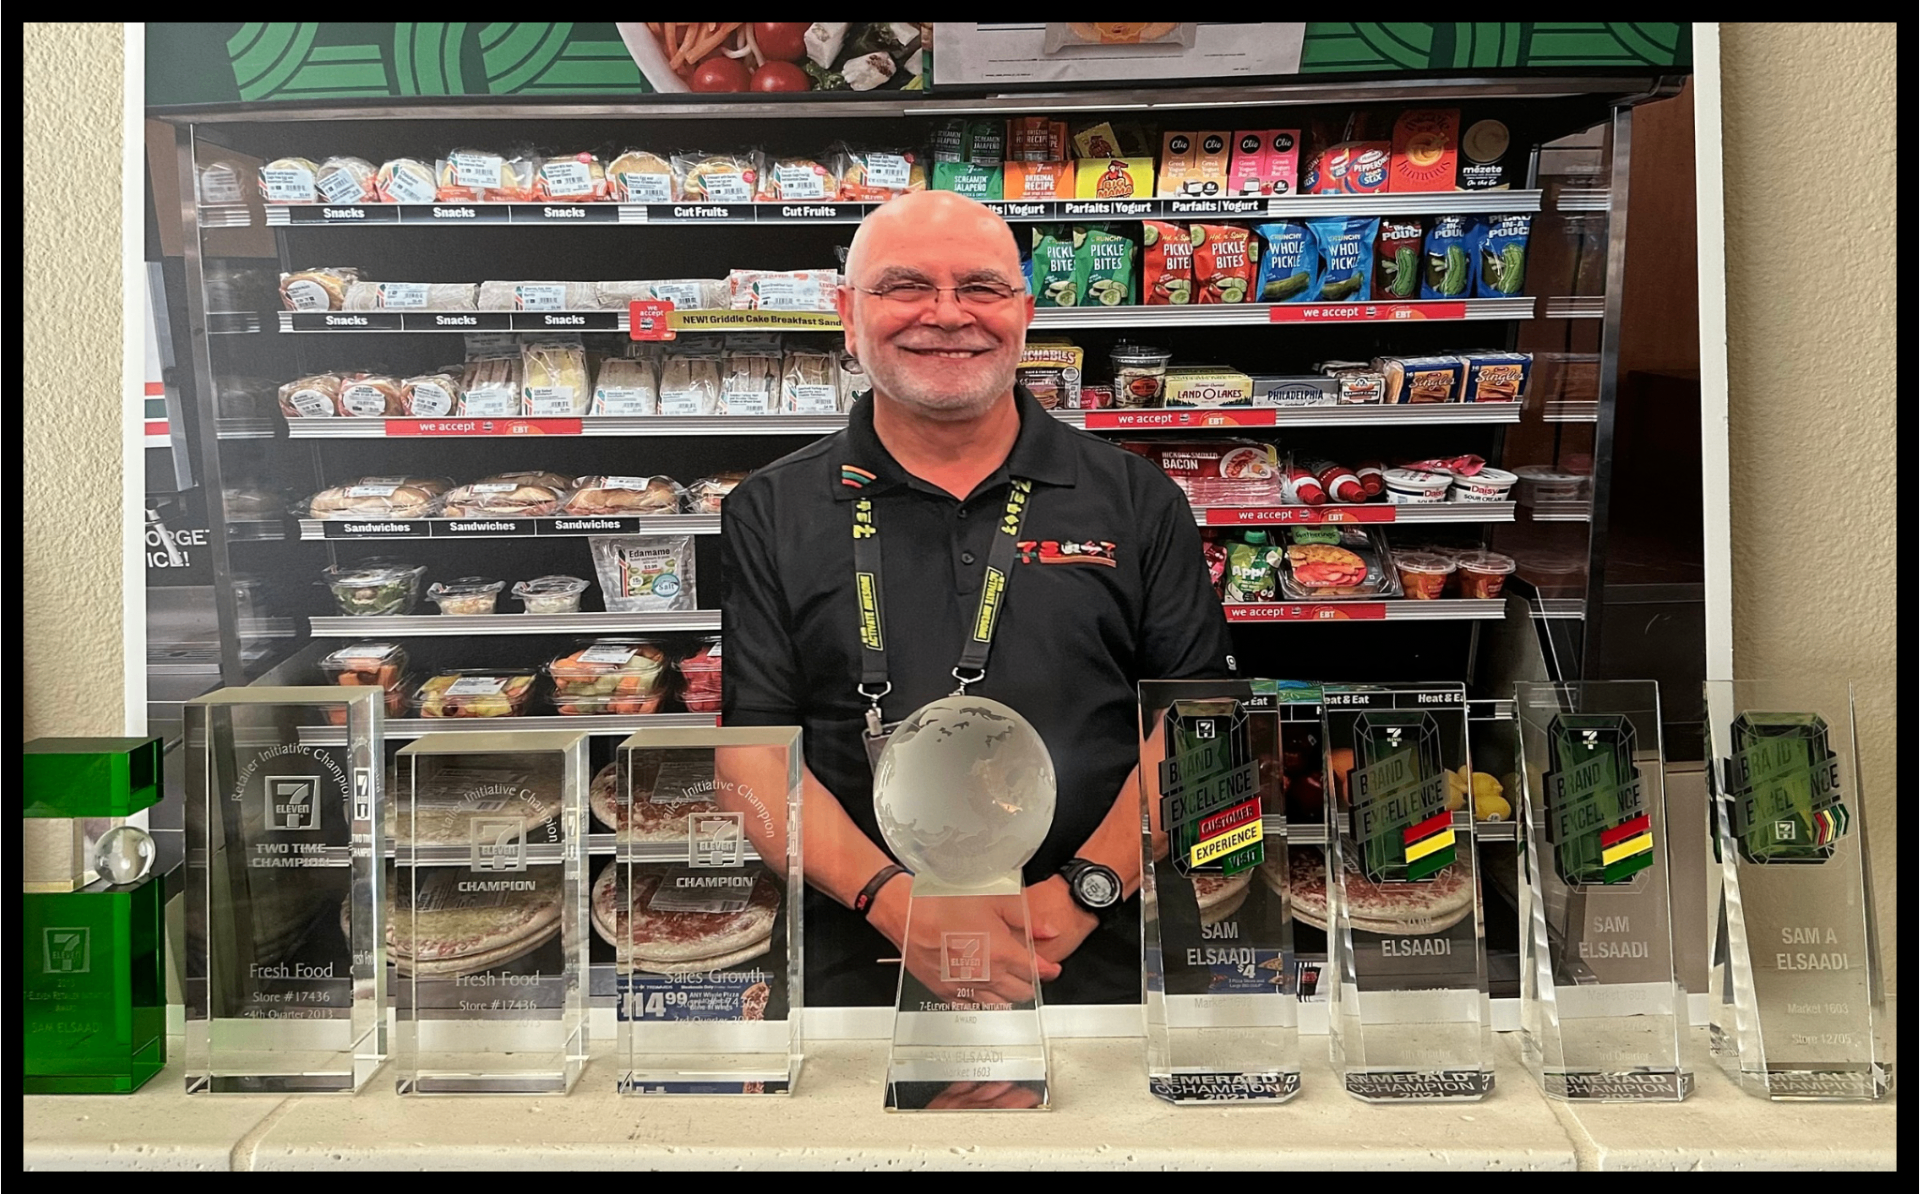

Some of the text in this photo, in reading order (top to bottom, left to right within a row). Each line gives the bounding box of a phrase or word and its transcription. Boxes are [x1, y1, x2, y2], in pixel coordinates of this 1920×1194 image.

[1172, 140, 1187, 149] Clio
[1205, 140, 1221, 149] Clio
[1242, 139, 1258, 149] Clio
[1275, 138, 1292, 147] Clio
[1396, 160, 1451, 180] hummus
[1025, 182, 1055, 190] RECIPE
[1103, 180, 1125, 188] BIG
[1097, 186, 1133, 198] MAMA
[323, 207, 365, 218] Snacks
[433, 207, 476, 218] Snacks
[544, 207, 585, 218] Snacks
[674, 206, 729, 217] Cut Fruits
[783, 206, 836, 217] Cut Fruits
[1008, 204, 1045, 216] Yogurt
[1065, 202, 1151, 215] Parfaits Yogurt
[1172, 200, 1258, 213] Parfaits Yogurt
[1090, 244, 1124, 256] PICKLE
[1212, 241, 1246, 255] PICKLE
[1269, 241, 1305, 254] WHOLE
[1329, 242, 1360, 256] WHOL
[1094, 258, 1122, 270] BITES
[1216, 255, 1244, 269] BITES
[1272, 256, 1301, 269] PICKLE
[1304, 307, 1358, 319] we accept
[1395, 310, 1412, 319] EBT
[326, 315, 367, 326] Snacks
[436, 315, 477, 325] Snacks
[545, 314, 585, 325] Snacks
[683, 316, 708, 324] NEW!
[710, 315, 744, 324] Griddle
[746, 315, 769, 323] Cake
[771, 316, 816, 325] Breakfast
[1409, 375, 1456, 390] Singles
[1475, 368, 1524, 385] Singles
[1177, 389, 1201, 400] LAND
[1217, 389, 1243, 399] LAKES
[1268, 389, 1324, 401] PHILADELPHIA
[1118, 414, 1173, 426] we accept
[1208, 417, 1224, 426] EBT
[419, 421, 475, 433] we accept
[513, 426, 529, 434] EBT
[1163, 459, 1198, 470] BACON
[1471, 486, 1498, 496] Daisy
[1239, 510, 1292, 521] we accept
[344, 522, 411, 533] Sandwiches
[450, 520, 516, 531] Sandwiches
[555, 519, 620, 530] Sandwiches
[629, 548, 671, 558] Edamame
[1249, 607, 1284, 617] accept
[864, 611, 880, 648] ACTIVATE
[1251, 696, 1268, 706] Eat
[1352, 695, 1369, 704] Eat
[1418, 694, 1452, 703] Heat &
[231, 742, 350, 802] Retailer Initiative Champion
[1360, 759, 1404, 796] BRAND
[1172, 769, 1252, 822] EXCELLENCE
[277, 783, 309, 828] 7
[682, 779, 775, 839] Initiative Champion
[464, 783, 558, 843] Initiative Champion
[1202, 805, 1253, 834] CUSTOMER
[256, 843, 327, 854] TWO TIME
[1196, 826, 1257, 860] EXPERIENCE
[252, 857, 330, 868] CHAMPION
[458, 880, 536, 892] CHAMPION
[676, 876, 754, 888] CHAMPION
[1201, 921, 1239, 939] SAM
[1593, 916, 1630, 933] SAM
[1781, 927, 1838, 944] SAM A
[1381, 938, 1452, 957] ELSAADI
[1578, 941, 1648, 959] ELSAADI
[1186, 948, 1256, 966] ELSAADI
[1776, 953, 1849, 970] ELSAADI
[250, 962, 333, 978] Fresh Food
[664, 966, 765, 985] Sales Growth
[1237, 964, 1256, 979] $4
[455, 970, 540, 987] Fresh Food
[253, 990, 331, 1003] Store #17436
[956, 988, 975, 998] 2011
[459, 999, 537, 1011] Store #17436
[919, 1002, 1013, 1011] 7-ELEVEN RETAILER INITIATIVE
[1788, 1003, 1849, 1014] Market 1603
[250, 1009, 333, 1020] 4th Quarter 2013
[954, 1015, 978, 1024] AWARD
[1792, 1034, 1818, 1044] Store
[972, 1067, 991, 1078] 1603
